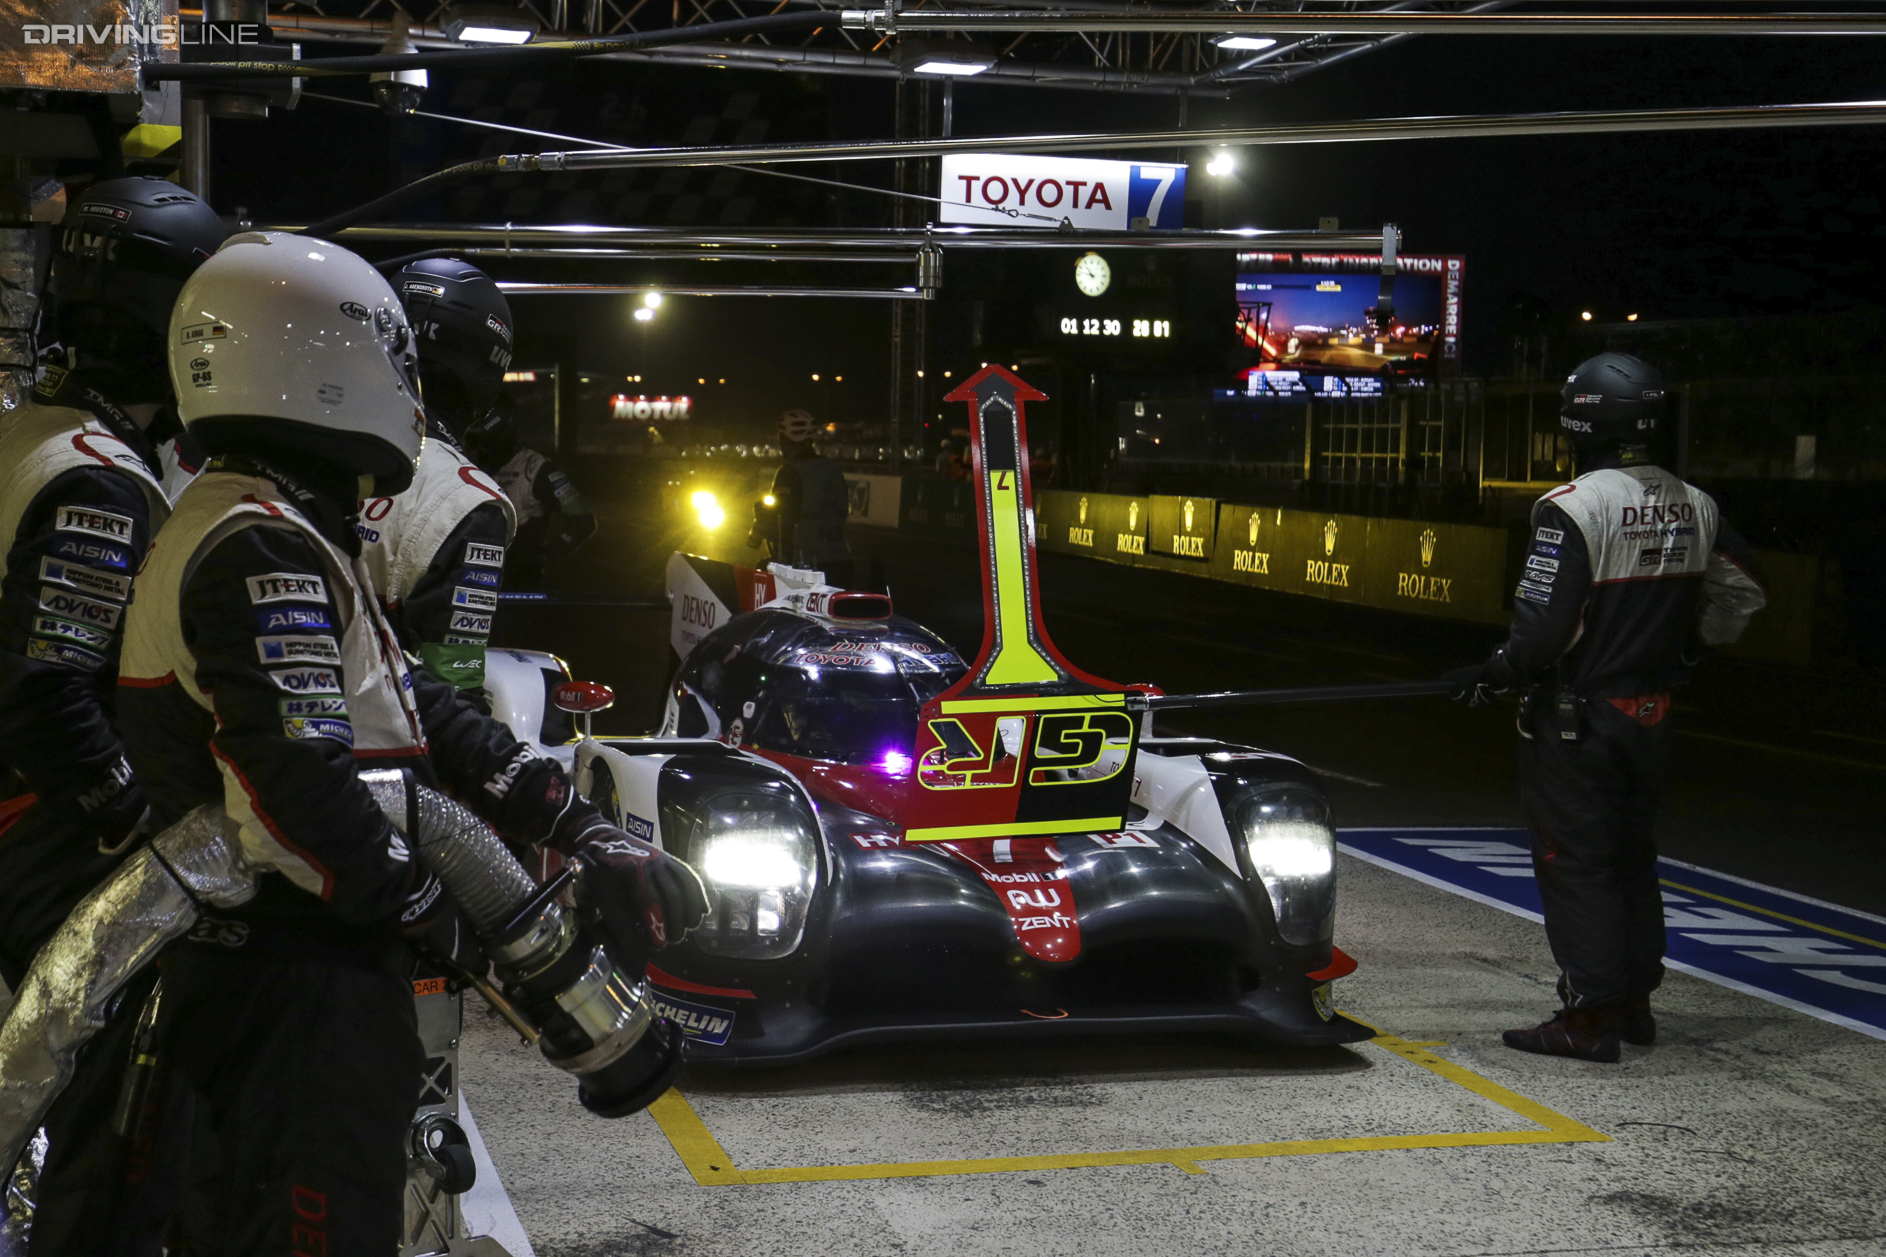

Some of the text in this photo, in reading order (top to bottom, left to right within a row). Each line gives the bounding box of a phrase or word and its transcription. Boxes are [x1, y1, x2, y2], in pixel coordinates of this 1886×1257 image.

[254, 61, 275, 71] stop
[958, 167, 1176, 227] TOYOTA 7
[1343, 257, 1442, 271] INSPIATION
[1445, 259, 1460, 334] DEMARRE
[347, 303, 368, 317] Arai
[487, 319, 501, 333] GR
[1061, 318, 1078, 334] 01
[1083, 319, 1100, 335] 12
[1103, 320, 1121, 336] 30
[613, 400, 690, 420] MOTUL
[62, 511, 128, 535] JTEKT
[1622, 503, 1692, 527] DENSO
[1069, 527, 1094, 547] ROLEX
[1623, 527, 1695, 540] TOYOTA HYBRID
[59, 541, 122, 563] AISIN
[469, 547, 502, 562] JTEKT
[1117, 534, 1145, 555] ROLEX
[1173, 535, 1204, 557] ROLEX
[1233, 550, 1269, 574] ROLEX
[66, 568, 94, 580] NIPPON
[95, 574, 114, 586] STEEL
[465, 571, 497, 583] AISIN
[1306, 560, 1349, 587] ROLEX
[66, 574, 125, 595] SUMITOMO METAL
[257, 578, 319, 600] JTEKT
[1397, 572, 1452, 602] ROLEX
[45, 595, 114, 623] ADVICS
[682, 595, 715, 629] DENSO
[268, 611, 324, 629] AISIN
[454, 616, 489, 630] ADVICS
[796, 653, 878, 666] TOYOTA
[628, 818, 651, 838] AISIN
[981, 872, 1040, 883] Mobil
[1018, 916, 1070, 930] ZENT
[414, 982, 437, 995] CAR
[654, 1000, 729, 1034] CHELIN
